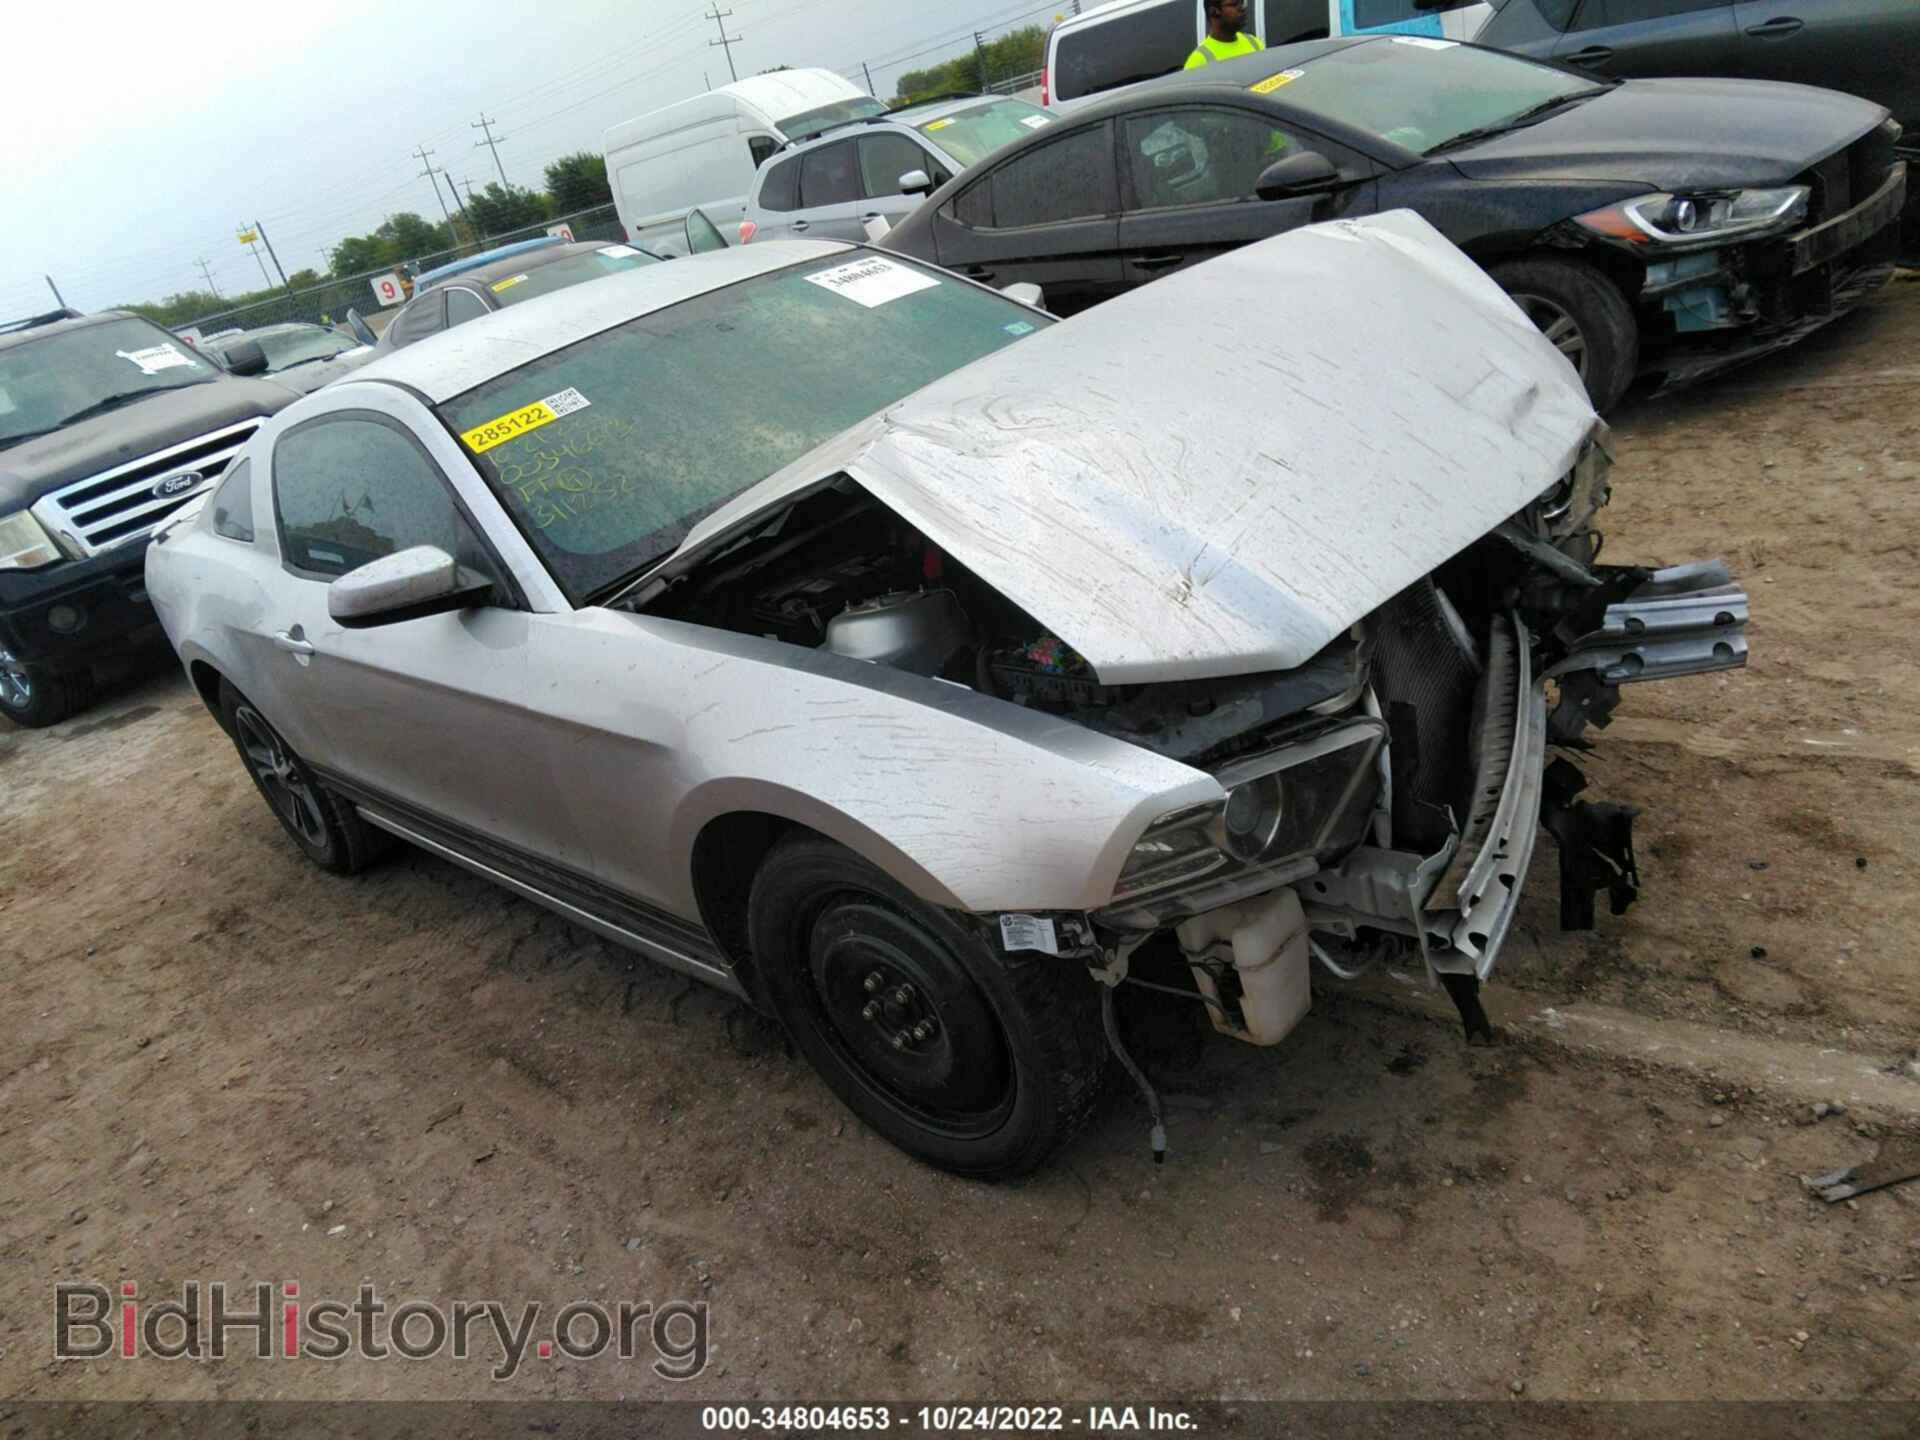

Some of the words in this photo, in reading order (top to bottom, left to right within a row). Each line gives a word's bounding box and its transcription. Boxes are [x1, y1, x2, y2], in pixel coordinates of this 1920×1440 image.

[382, 281, 396, 299] 9
[471, 406, 549, 446] 285122
[165, 475, 193, 493] Ford
